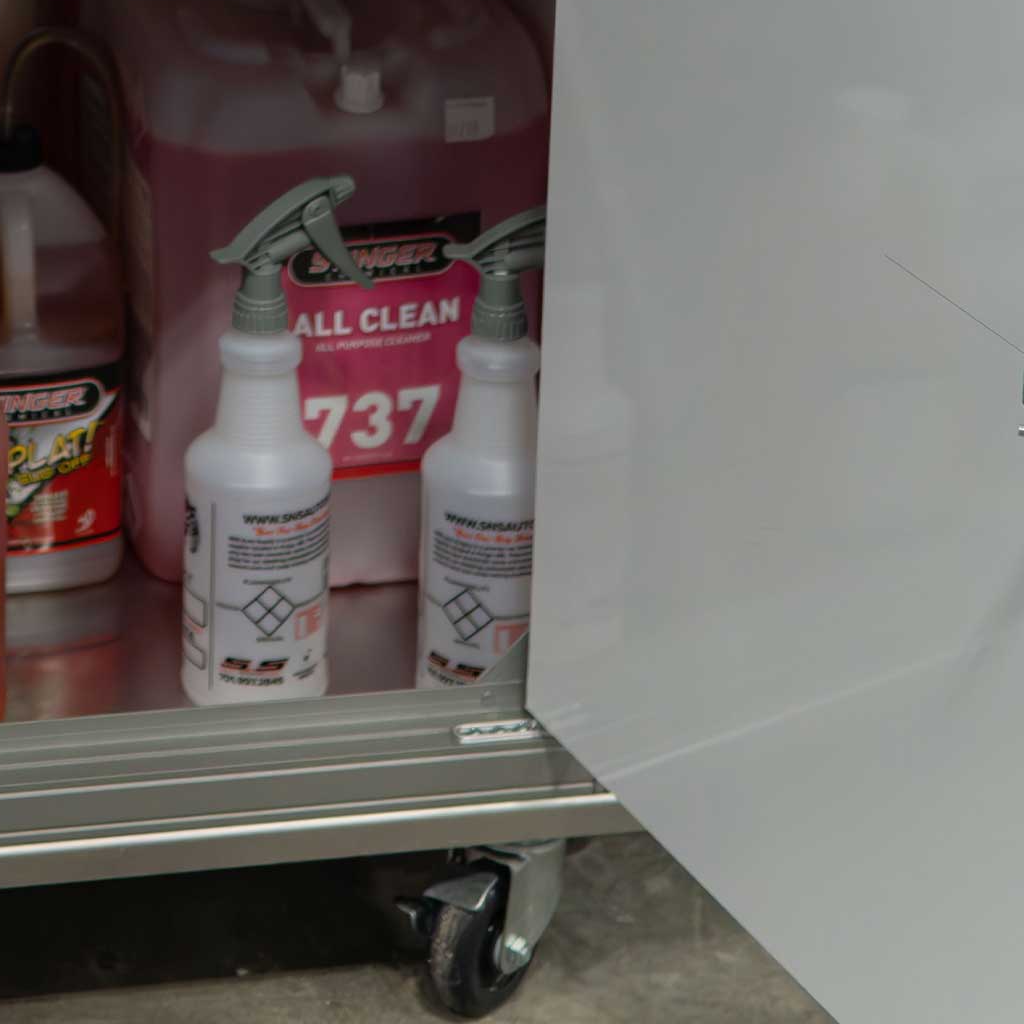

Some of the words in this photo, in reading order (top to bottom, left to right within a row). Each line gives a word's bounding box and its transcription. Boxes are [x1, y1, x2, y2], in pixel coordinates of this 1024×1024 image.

[292, 310, 353, 338] ALL
[359, 296, 462, 334] CLEAN
[303, 384, 443, 451] 737
[8, 421, 98, 470] PLAT!
